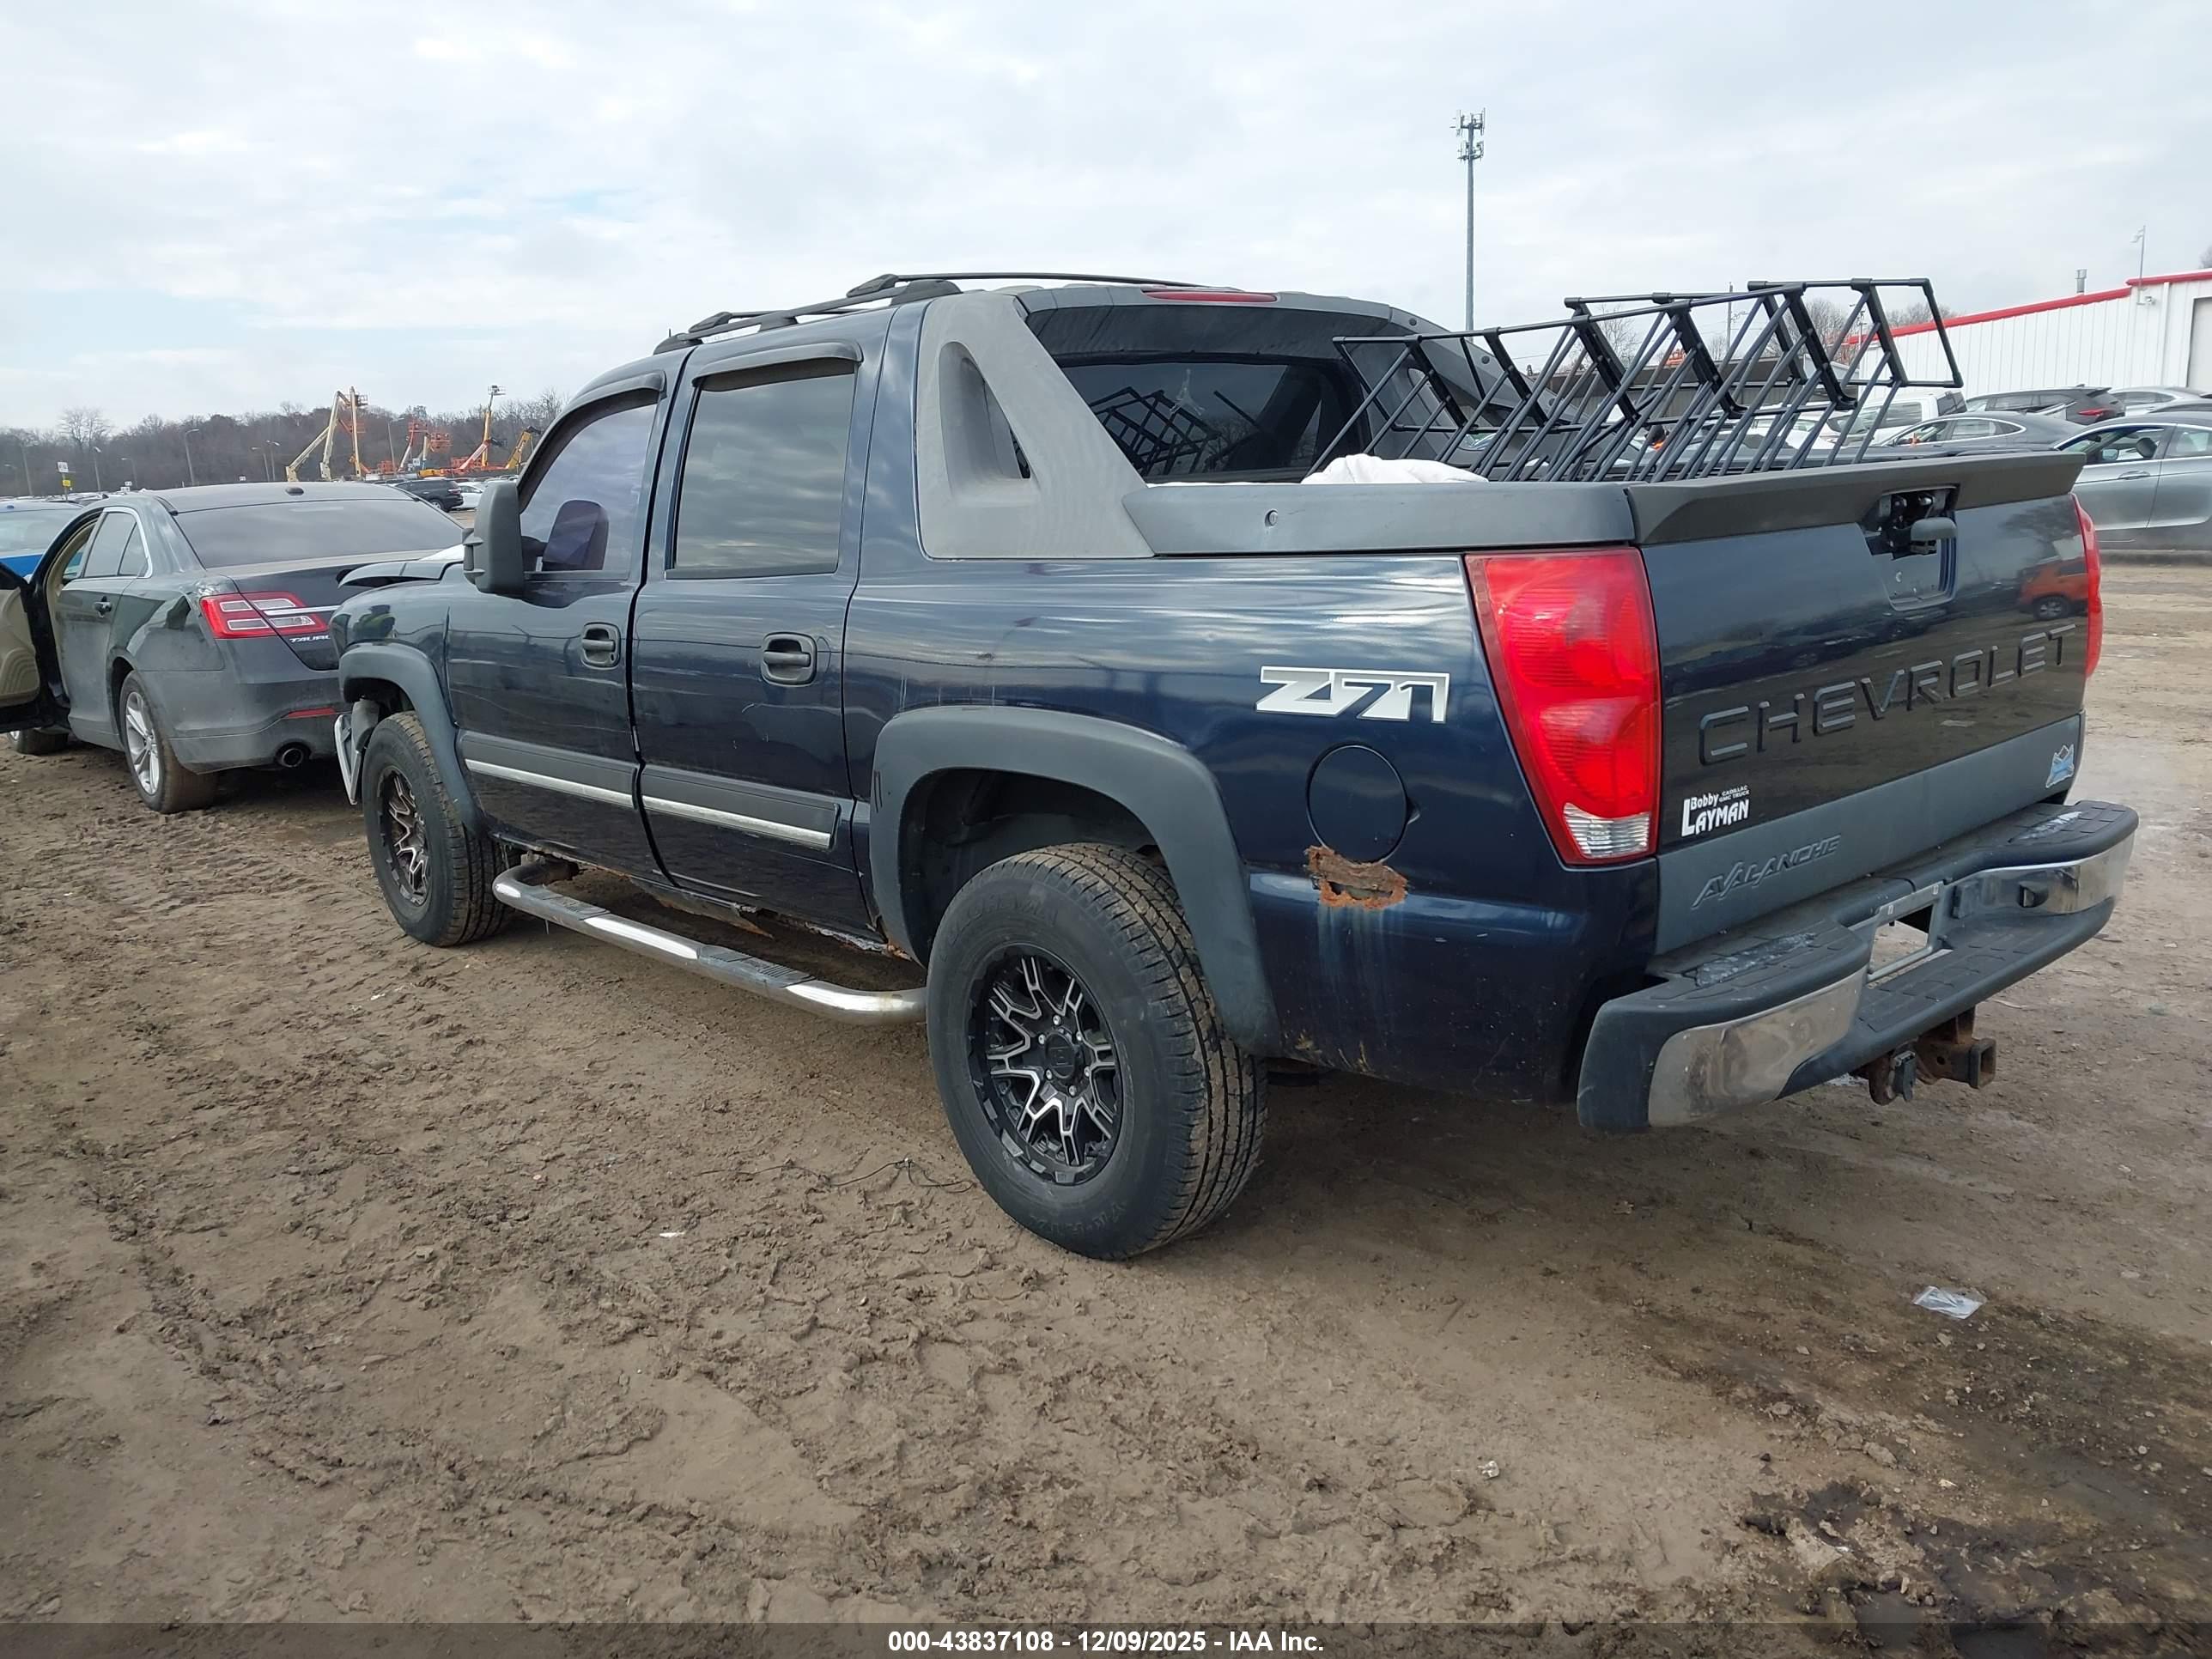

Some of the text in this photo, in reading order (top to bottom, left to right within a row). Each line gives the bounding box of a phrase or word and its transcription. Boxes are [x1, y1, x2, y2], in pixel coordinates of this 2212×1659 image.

[1255, 665, 1450, 723] Z71
[1698, 623, 2076, 766] CHEVROLET
[1689, 793, 1719, 811] Bobby
[1718, 789, 1750, 803] GMC TRUCK
[1721, 785, 1748, 797] CADILLAC
[1681, 799, 1749, 837] LAYMAN
[1691, 835, 1841, 909] AVALANCHE
